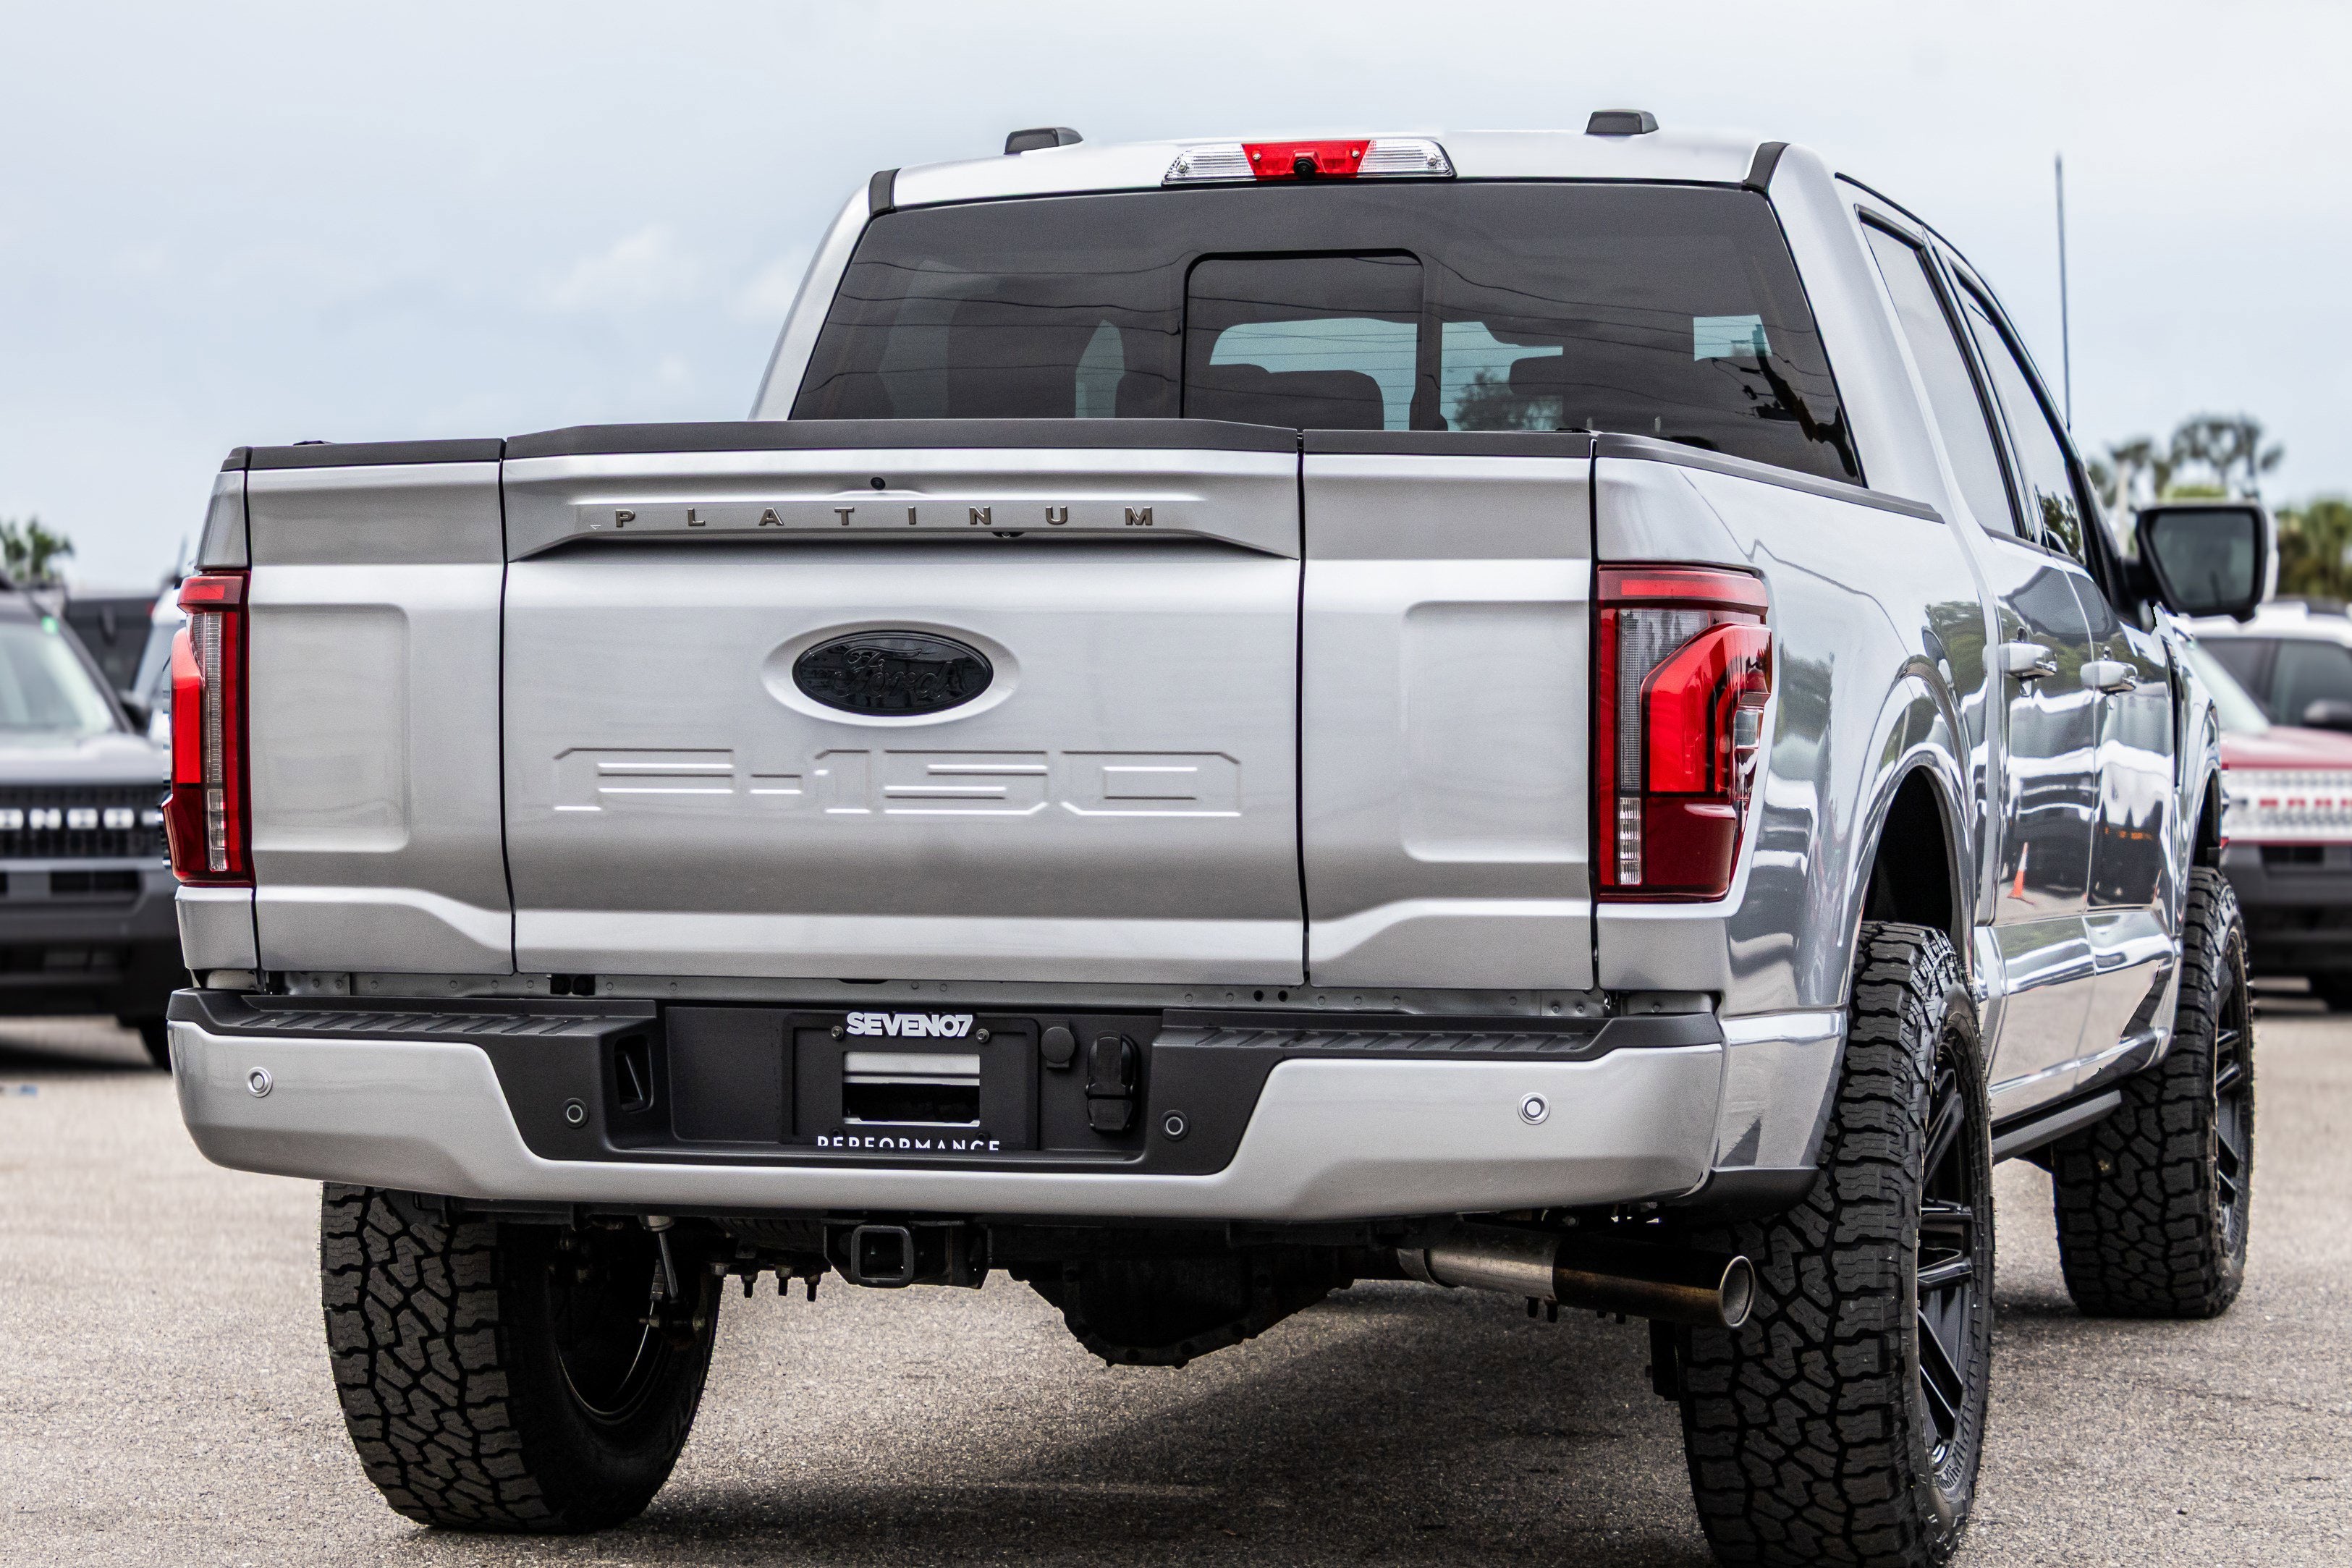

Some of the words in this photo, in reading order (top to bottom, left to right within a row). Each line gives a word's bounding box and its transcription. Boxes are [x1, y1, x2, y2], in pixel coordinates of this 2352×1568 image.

[614, 507, 1153, 527] PLATINUM
[832, 643, 953, 700] Ford
[553, 747, 1241, 817] F-150
